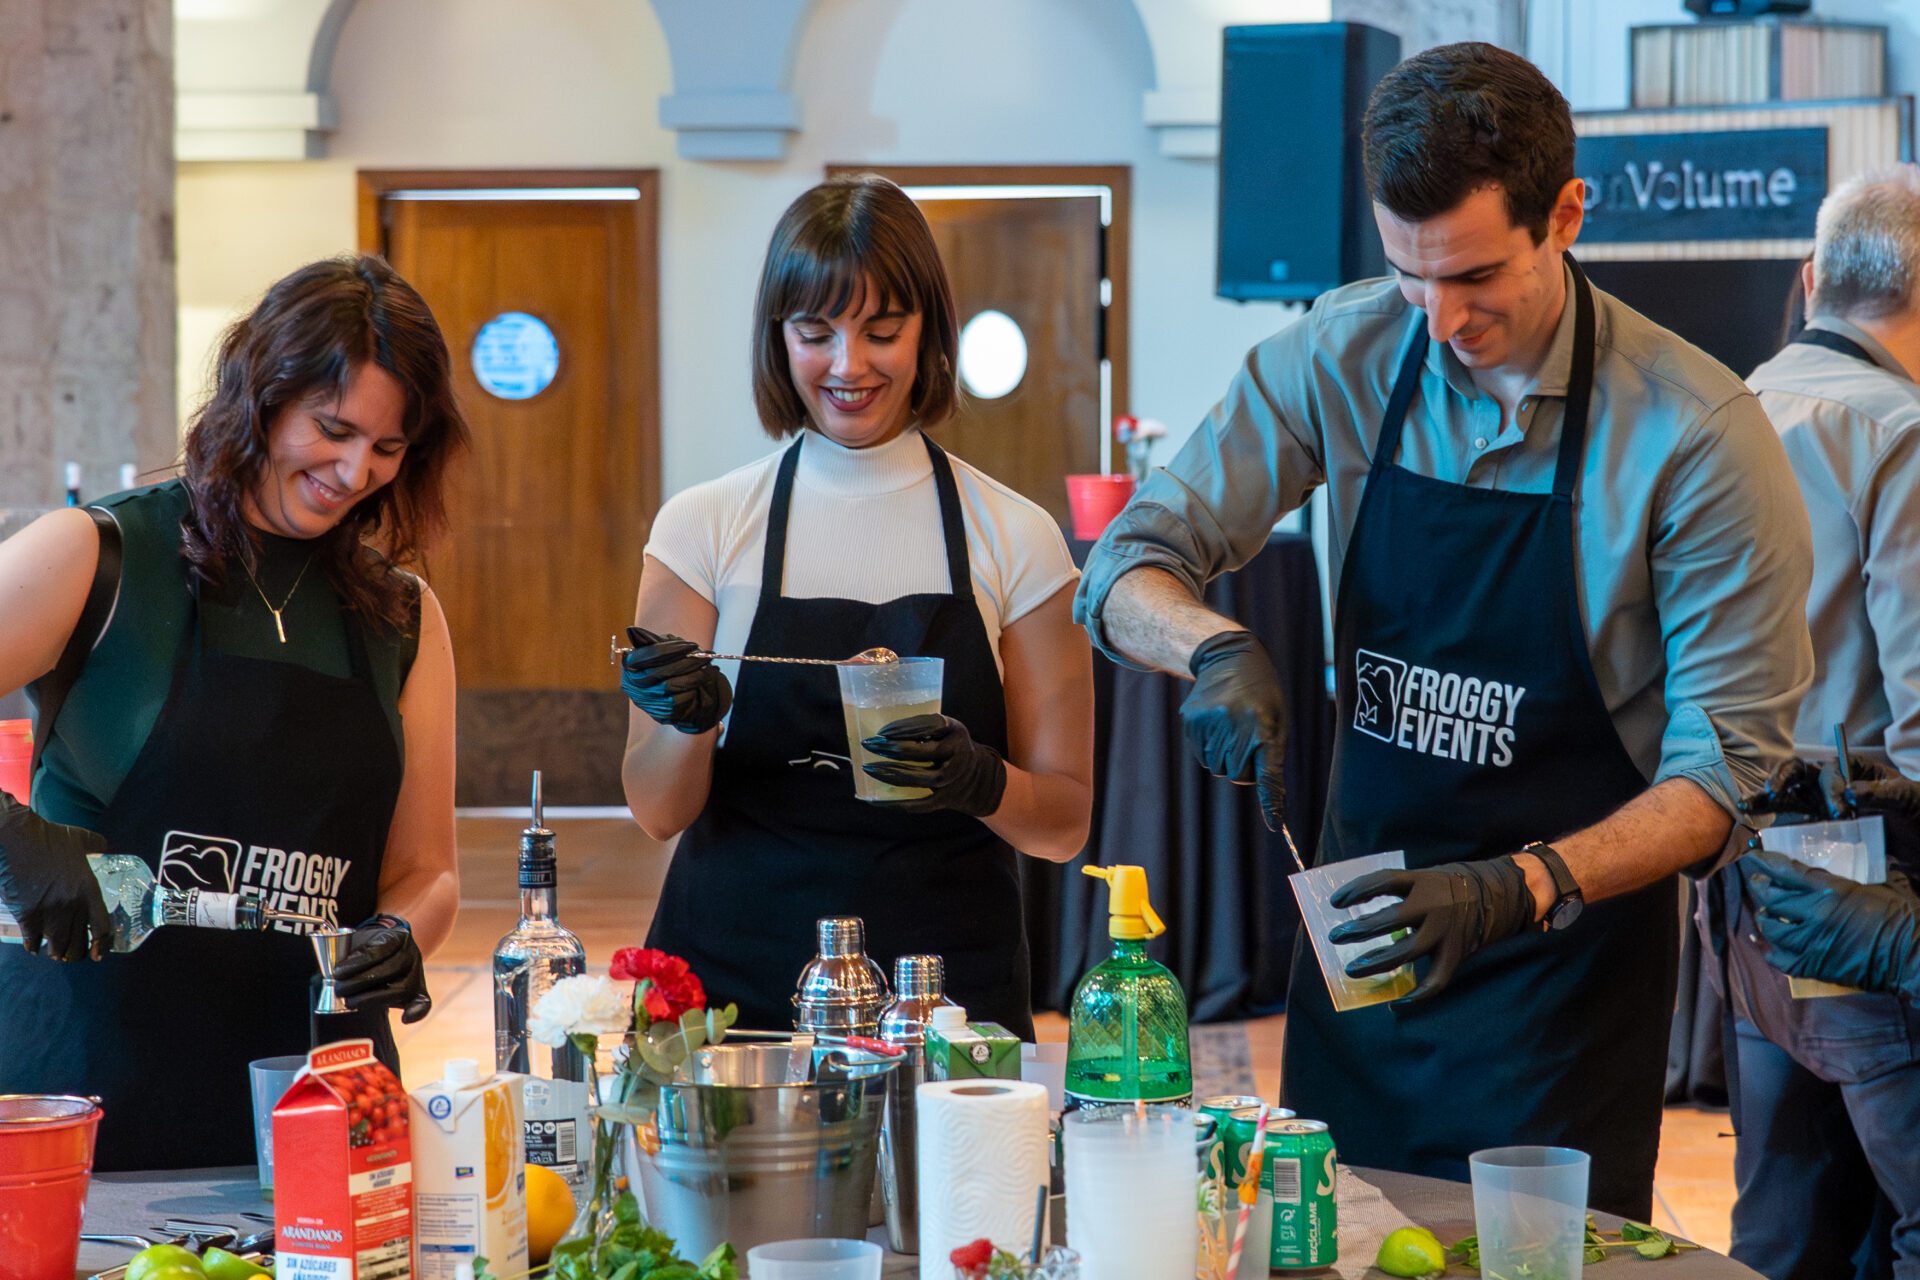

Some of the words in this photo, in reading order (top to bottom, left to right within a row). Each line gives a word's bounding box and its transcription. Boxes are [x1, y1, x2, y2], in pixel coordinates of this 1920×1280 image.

[1404, 665, 1526, 727] FROGGY
[1397, 706, 1516, 768] EVENTS
[242, 845, 352, 898] FROGGY
[281, 1223, 343, 1243] ARÁNDANOS
